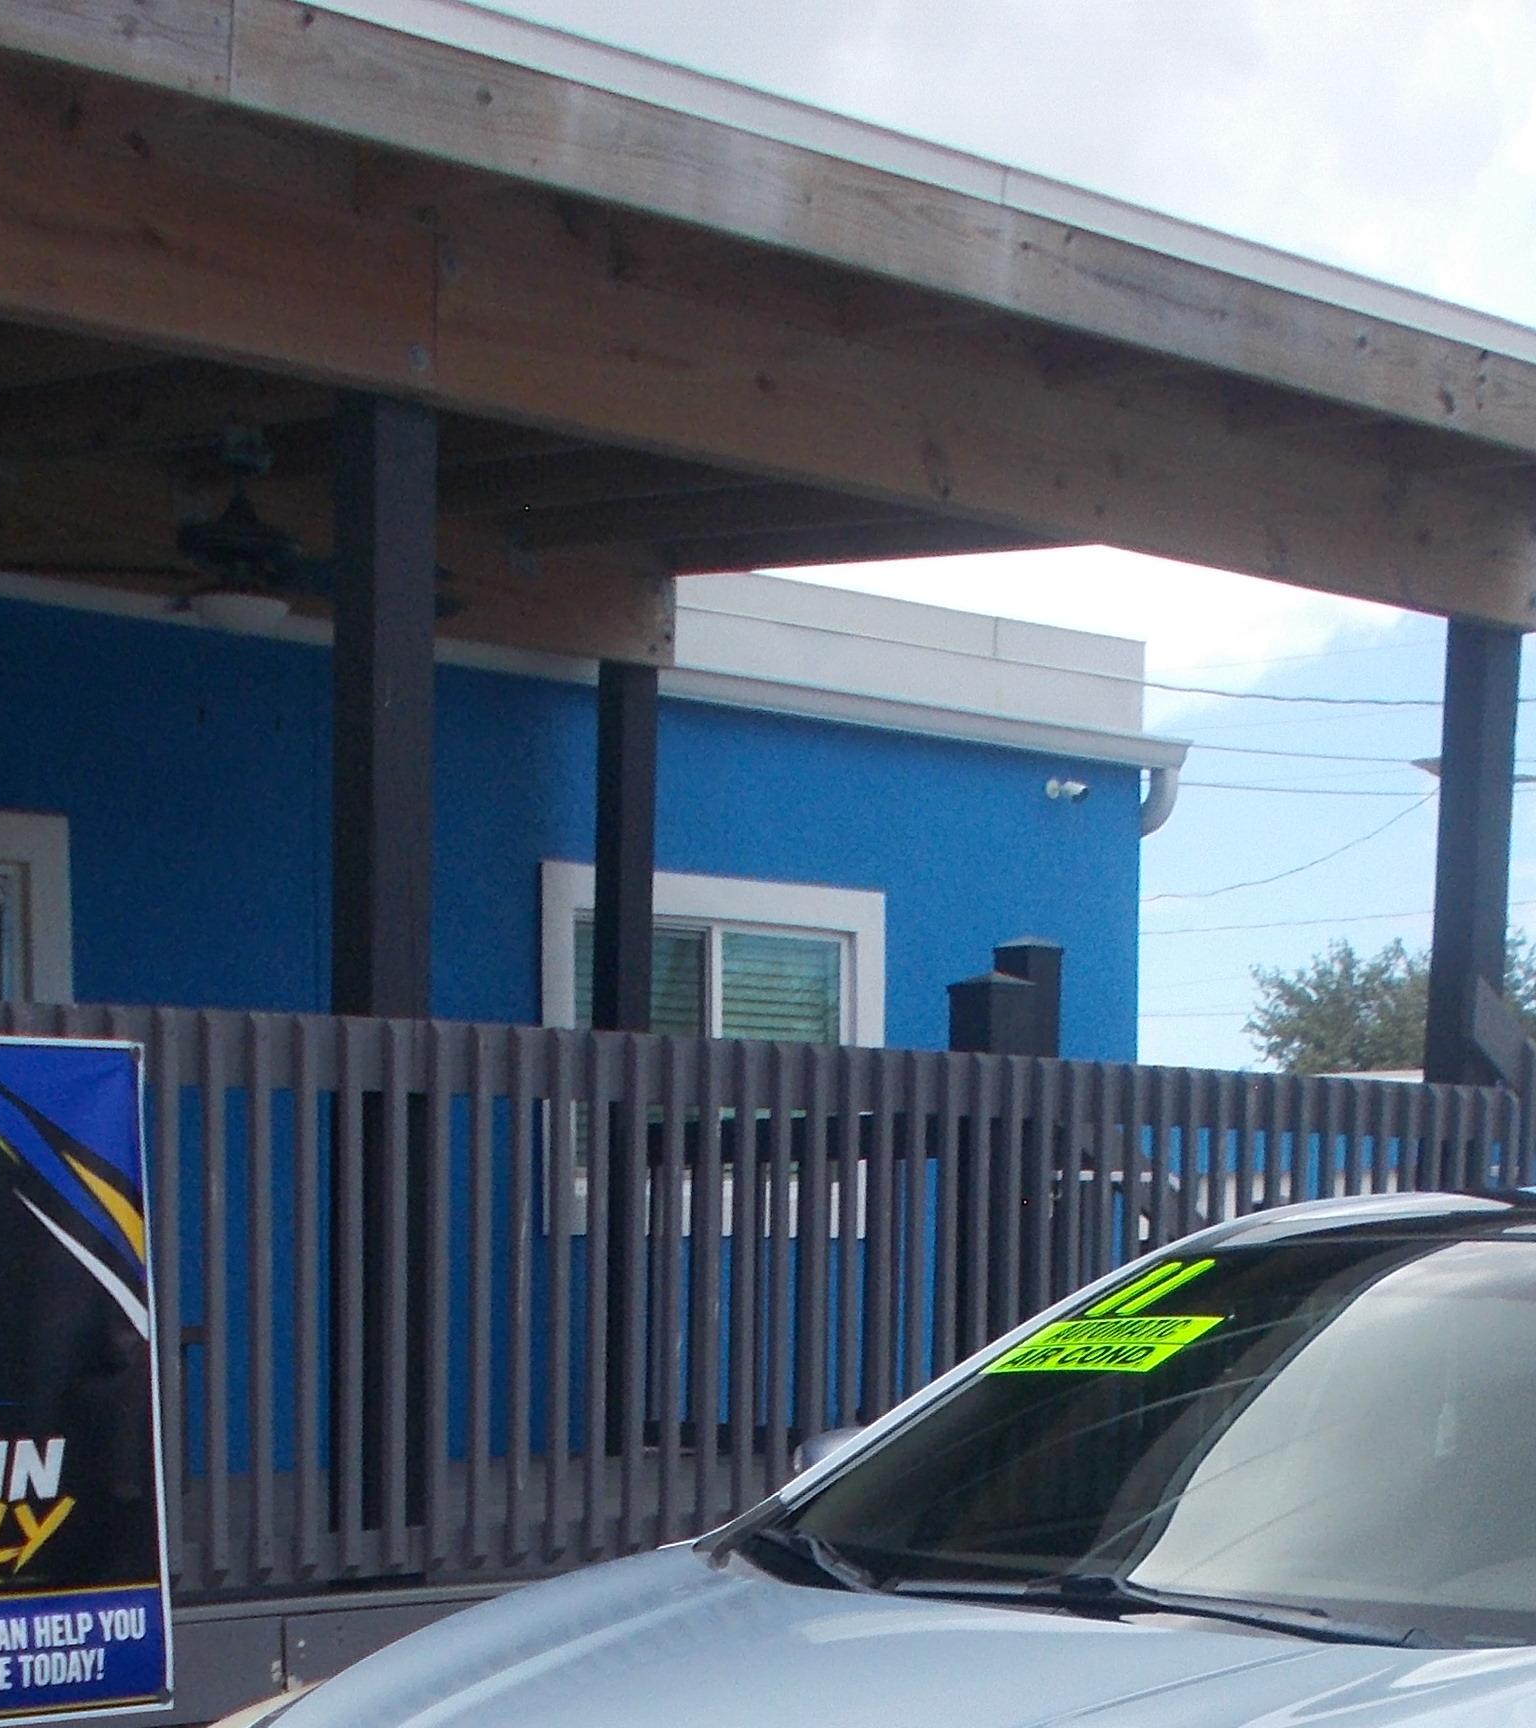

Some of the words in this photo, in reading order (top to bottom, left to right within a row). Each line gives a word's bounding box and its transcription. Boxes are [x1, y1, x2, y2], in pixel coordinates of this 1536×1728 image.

[1003, 1346, 1066, 1368] AIR
[33, 1611, 94, 1649] HELP
[97, 1607, 147, 1642] YOU
[19, 1646, 106, 1690] TODAY!
